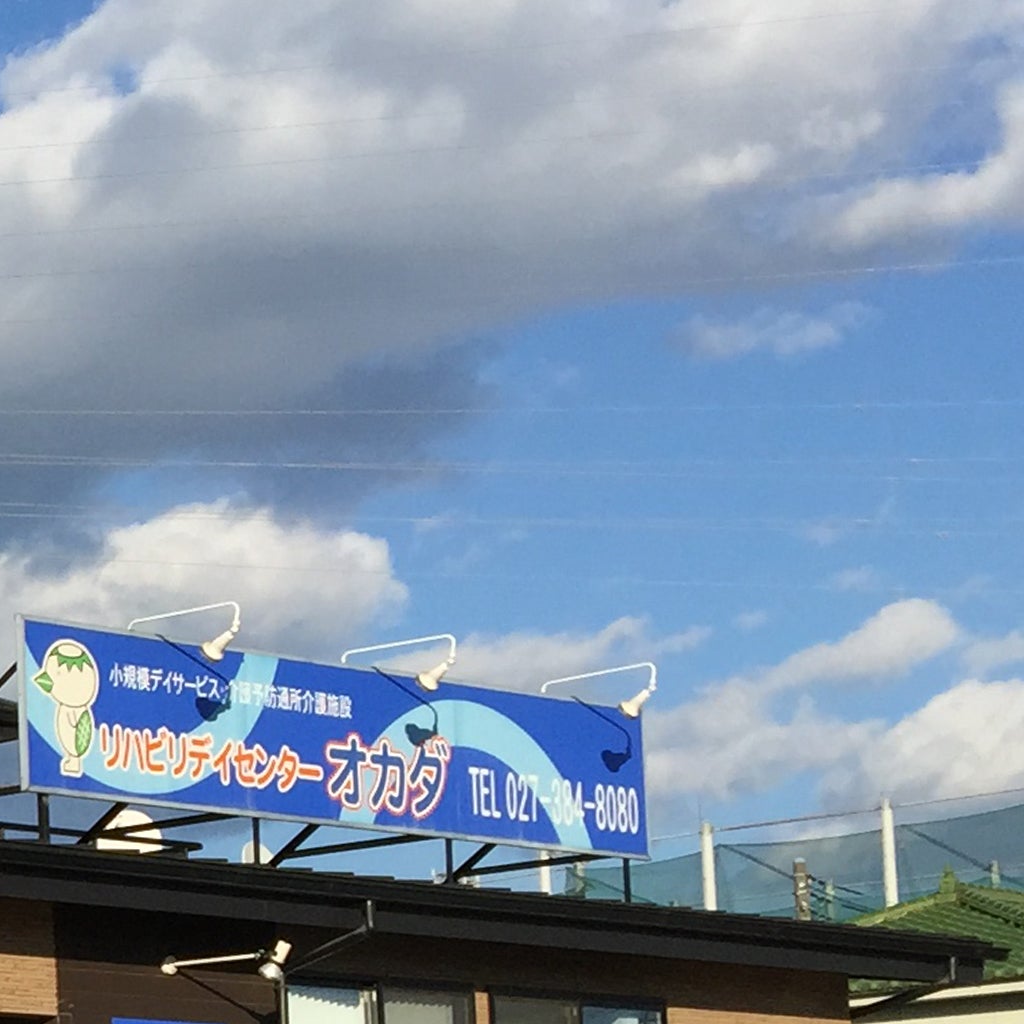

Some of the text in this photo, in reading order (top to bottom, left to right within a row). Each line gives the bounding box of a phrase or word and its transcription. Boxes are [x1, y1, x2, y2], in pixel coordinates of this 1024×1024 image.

[100, 723, 451, 818] リハビリデイセンター オカダ
[469, 767, 640, 835] TEL 027-384-8080
